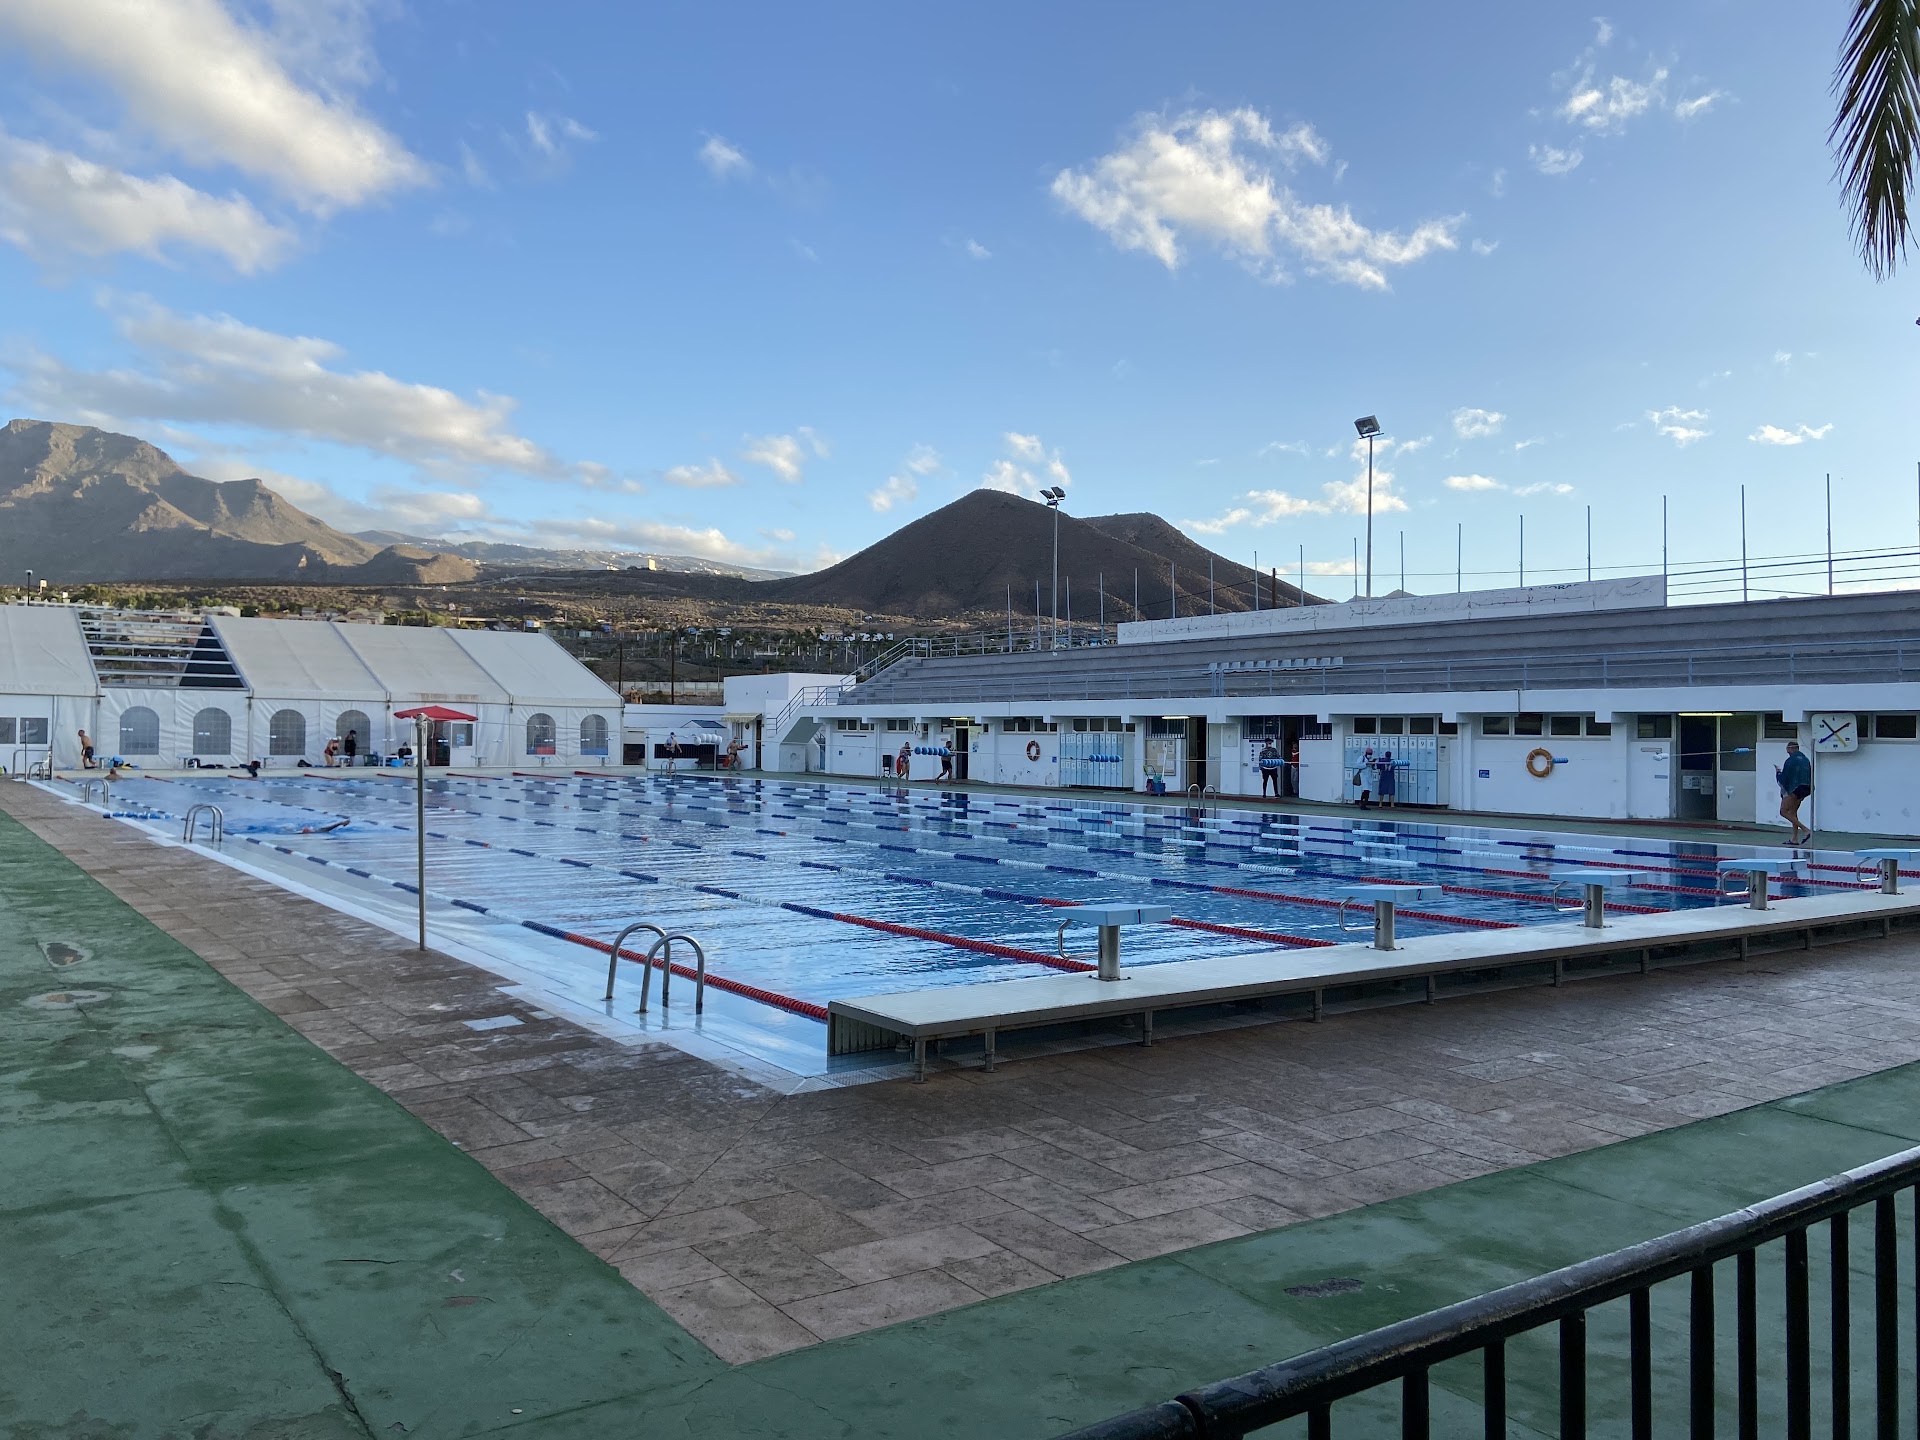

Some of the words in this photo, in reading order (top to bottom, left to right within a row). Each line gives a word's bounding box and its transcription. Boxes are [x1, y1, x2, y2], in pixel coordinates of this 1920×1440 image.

[1627, 874, 1632, 884] 3
[1884, 871, 1889, 880] 5
[1751, 884, 1757, 894] 4
[1417, 889, 1422, 901] 2
[1586, 900, 1592, 910] 3
[1375, 918, 1381, 930] 2
